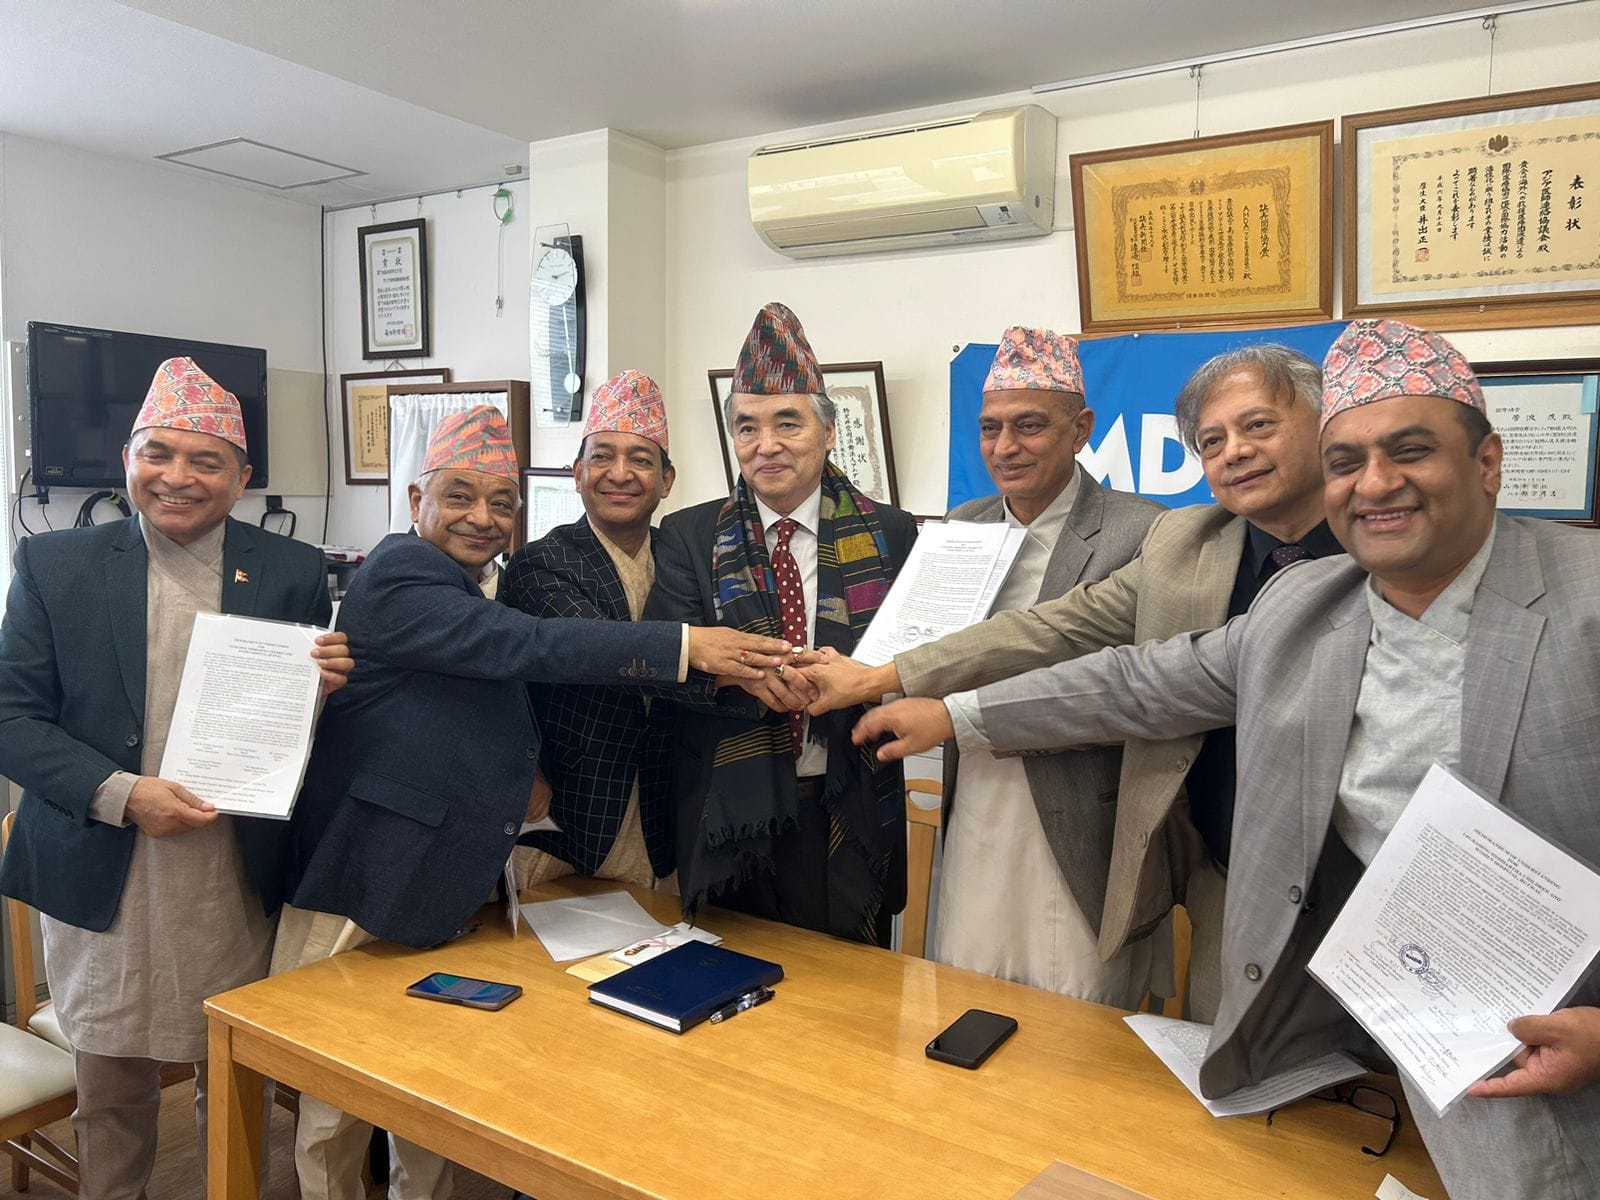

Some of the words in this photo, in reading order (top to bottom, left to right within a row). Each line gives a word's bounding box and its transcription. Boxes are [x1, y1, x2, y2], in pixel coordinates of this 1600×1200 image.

[1565, 174, 1584, 231] 表彰状
[1074, 411, 1216, 497] MD
